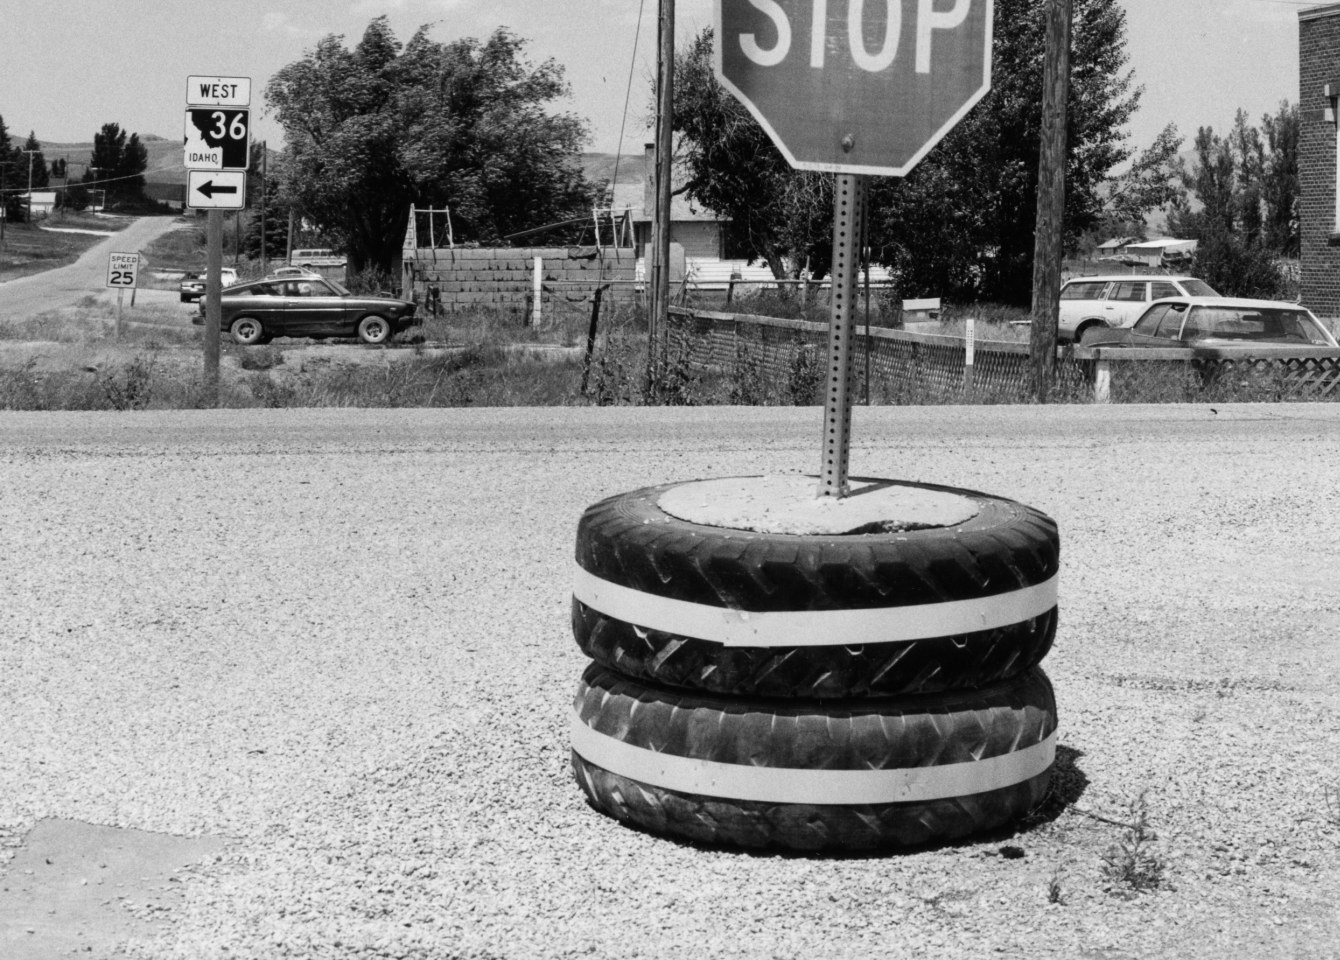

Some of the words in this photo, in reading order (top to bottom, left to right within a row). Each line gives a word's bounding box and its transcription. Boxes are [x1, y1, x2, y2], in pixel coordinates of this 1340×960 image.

[199, 83, 238, 99] WEST
[209, 111, 246, 140] 36
[188, 152, 218, 163] IDAHO
[111, 255, 137, 263] SPEED
[110, 270, 134, 285] 25
